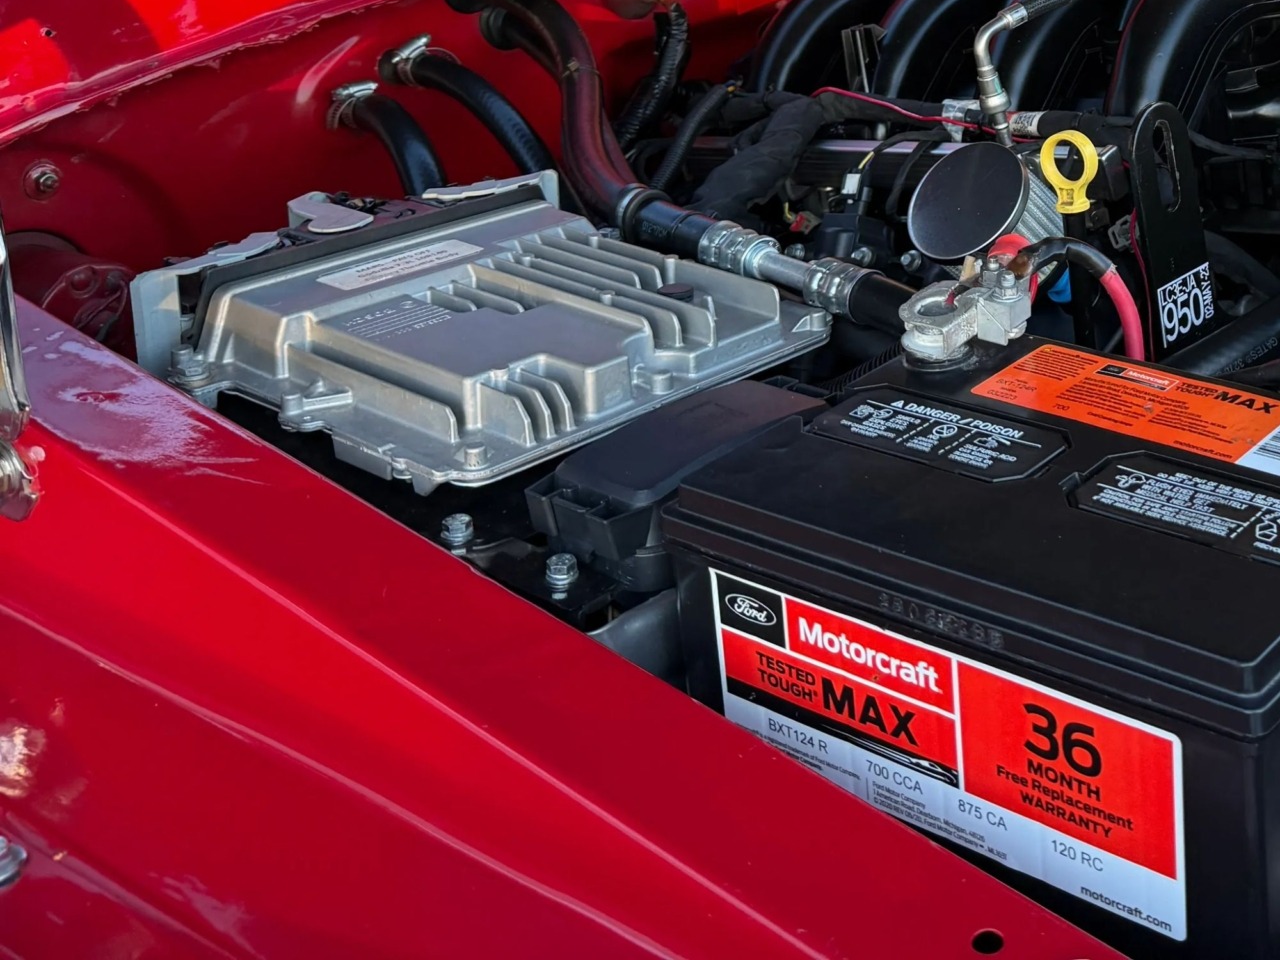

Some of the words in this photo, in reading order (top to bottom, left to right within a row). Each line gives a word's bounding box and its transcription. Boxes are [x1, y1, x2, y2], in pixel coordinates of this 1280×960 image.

[1163, 287, 1205, 342] 950
[1127, 369, 1170, 385] Motorcraft
[904, 402, 961, 422] DANGER
[970, 419, 1024, 439] POISON
[1214, 391, 1279, 414] MAX
[1146, 479, 1173, 490] FLUSH
[1172, 485, 1195, 496] EYES
[1194, 492, 1249, 511] IMMEDIATELY
[1191, 504, 1216, 514] FAST
[1192, 497, 1213, 506] GET
[734, 596, 768, 623] Ford
[756, 651, 816, 686] TESTED
[798, 616, 940, 693] Motorcraft
[821, 676, 919, 747] MAX
[768, 718, 815, 748] BXT124
[818, 740, 829, 754] R
[1023, 703, 1102, 778] 36
[866, 759, 890, 780] 700
[892, 771, 923, 795] CCA
[872, 780, 885, 791] Ford
[885, 784, 900, 797] Motor
[900, 791, 926, 810] Company
[1027, 758, 1102, 802] MONTH
[958, 799, 983, 820] 875
[986, 811, 1008, 831] CA
[996, 764, 1029, 788] Free
[1031, 778, 1134, 832] Replacement
[1020, 790, 1113, 838] WARRANTY
[1051, 840, 1077, 861] 120
[1081, 851, 1104, 872] RC
[1080, 886, 1172, 932] motorcraft.com
